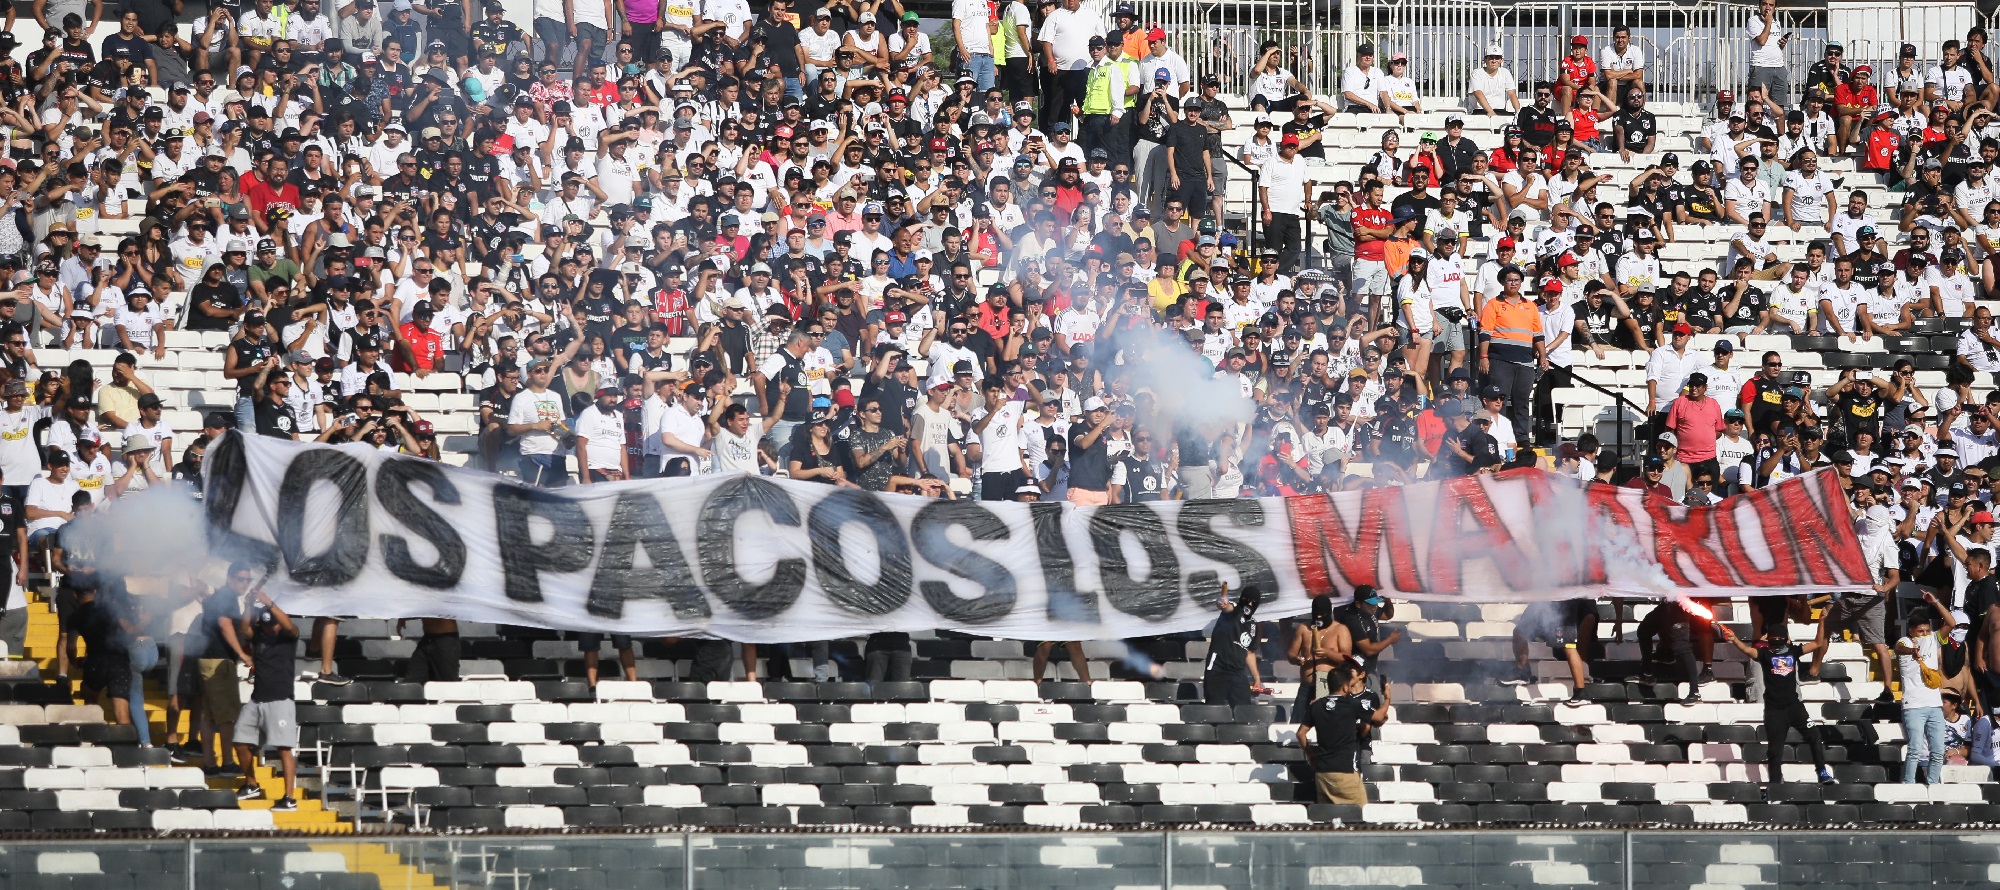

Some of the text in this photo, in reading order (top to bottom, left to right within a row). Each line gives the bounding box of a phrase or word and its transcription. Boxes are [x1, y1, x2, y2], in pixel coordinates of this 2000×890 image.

[579, 127, 590, 137] MG
[1371, 216, 1380, 225] 14
[1602, 243, 1615, 254] MG
[659, 310, 682, 318] DIRECTV
[1739, 306, 1752, 318] MG
[1838, 307, 1850, 319] MG
[277, 416, 291, 430] MG
[1144, 476, 1156, 489] MG
[204, 430, 466, 588] LOS
[495, 474, 1016, 623] PACOS
[1031, 500, 1279, 621] LOS
